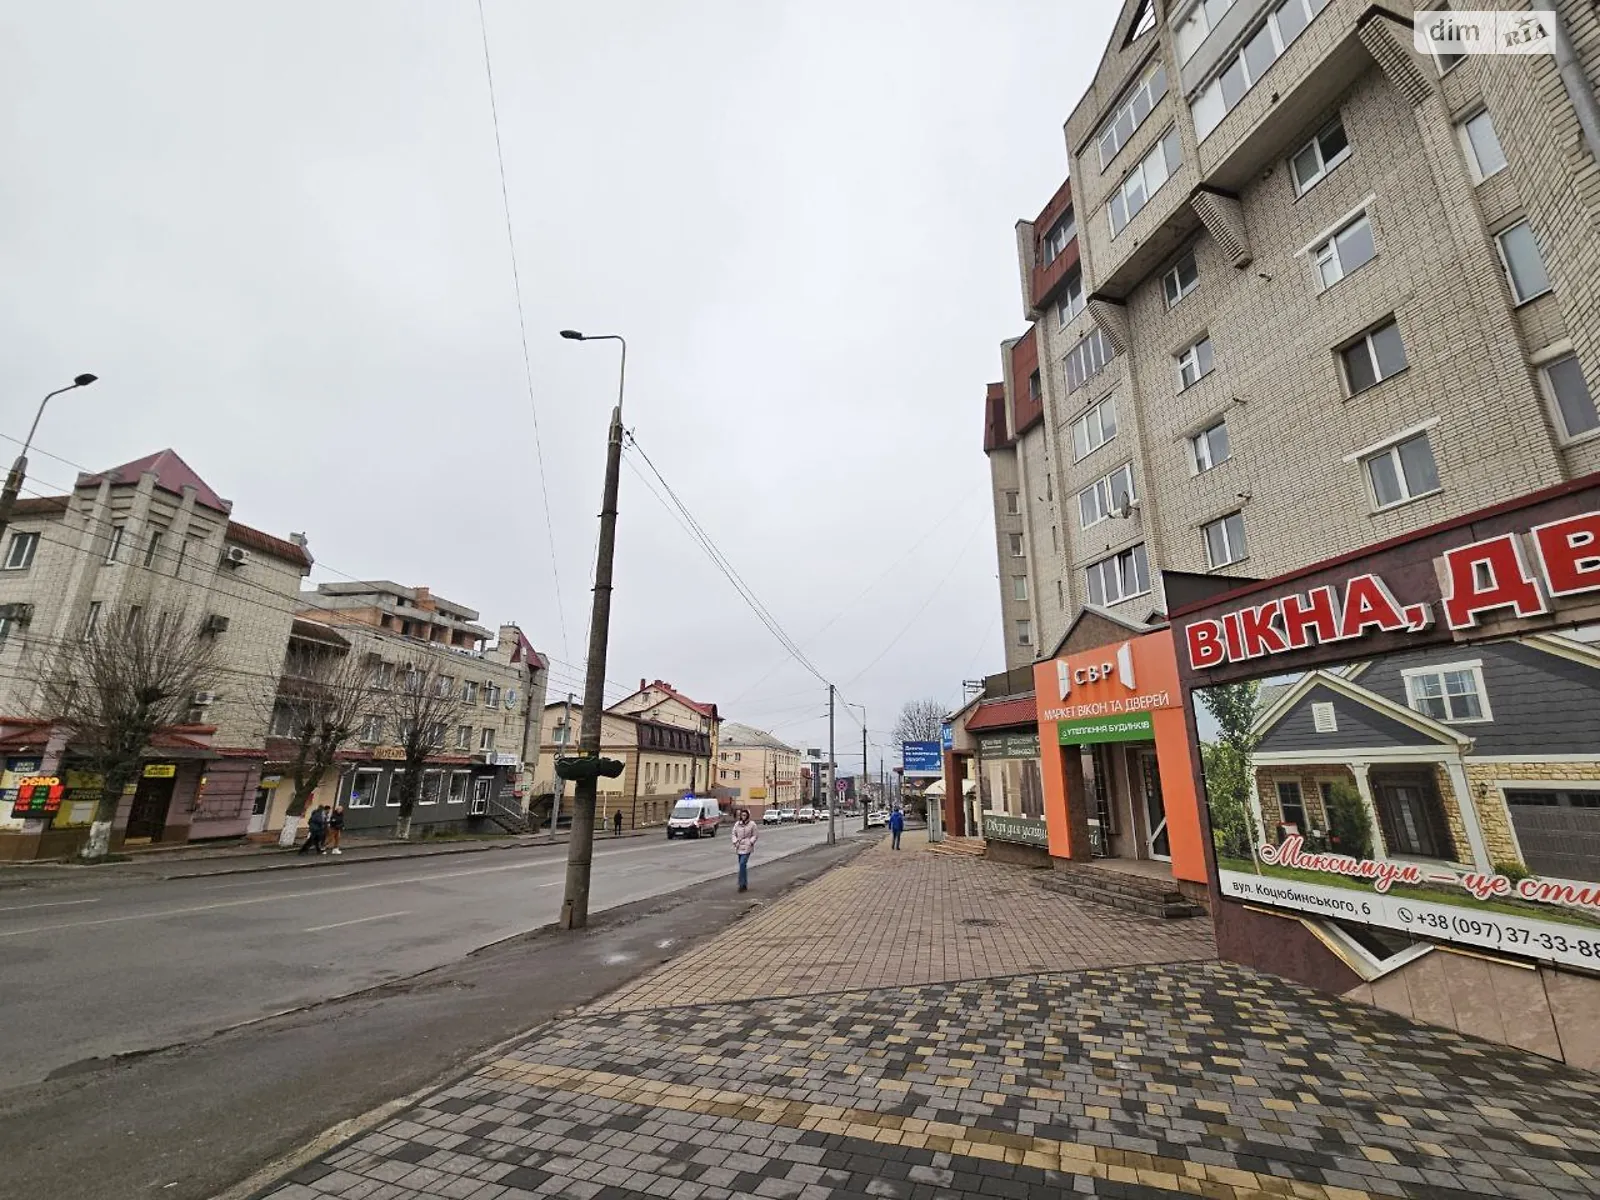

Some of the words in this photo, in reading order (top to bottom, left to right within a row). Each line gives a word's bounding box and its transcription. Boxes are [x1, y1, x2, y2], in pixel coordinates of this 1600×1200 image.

[1185, 573, 1432, 670] ВІКНА,
[1074, 662, 1114, 685] СВР
[1044, 705, 1076, 721] МАРКЕТ
[1078, 702, 1107, 717] ВІКОН
[1110, 700, 1123, 712] ТА
[1125, 690, 1170, 713] ДВЕРЕЙ
[1067, 725, 1108, 737] УТЕПЛЕННЯ
[1108, 720, 1150, 732] БУДИНКІВ
[1259, 835, 1421, 893] Максимум
[1464, 873, 1511, 900] це
[1232, 881, 1254, 894] вул.
[1256, 884, 1358, 914] Коцюбинського,
[1362, 904, 1371, 915] 6
[1417, 913, 1448, 930] +38
[1452, 916, 1502, 943] (097)
